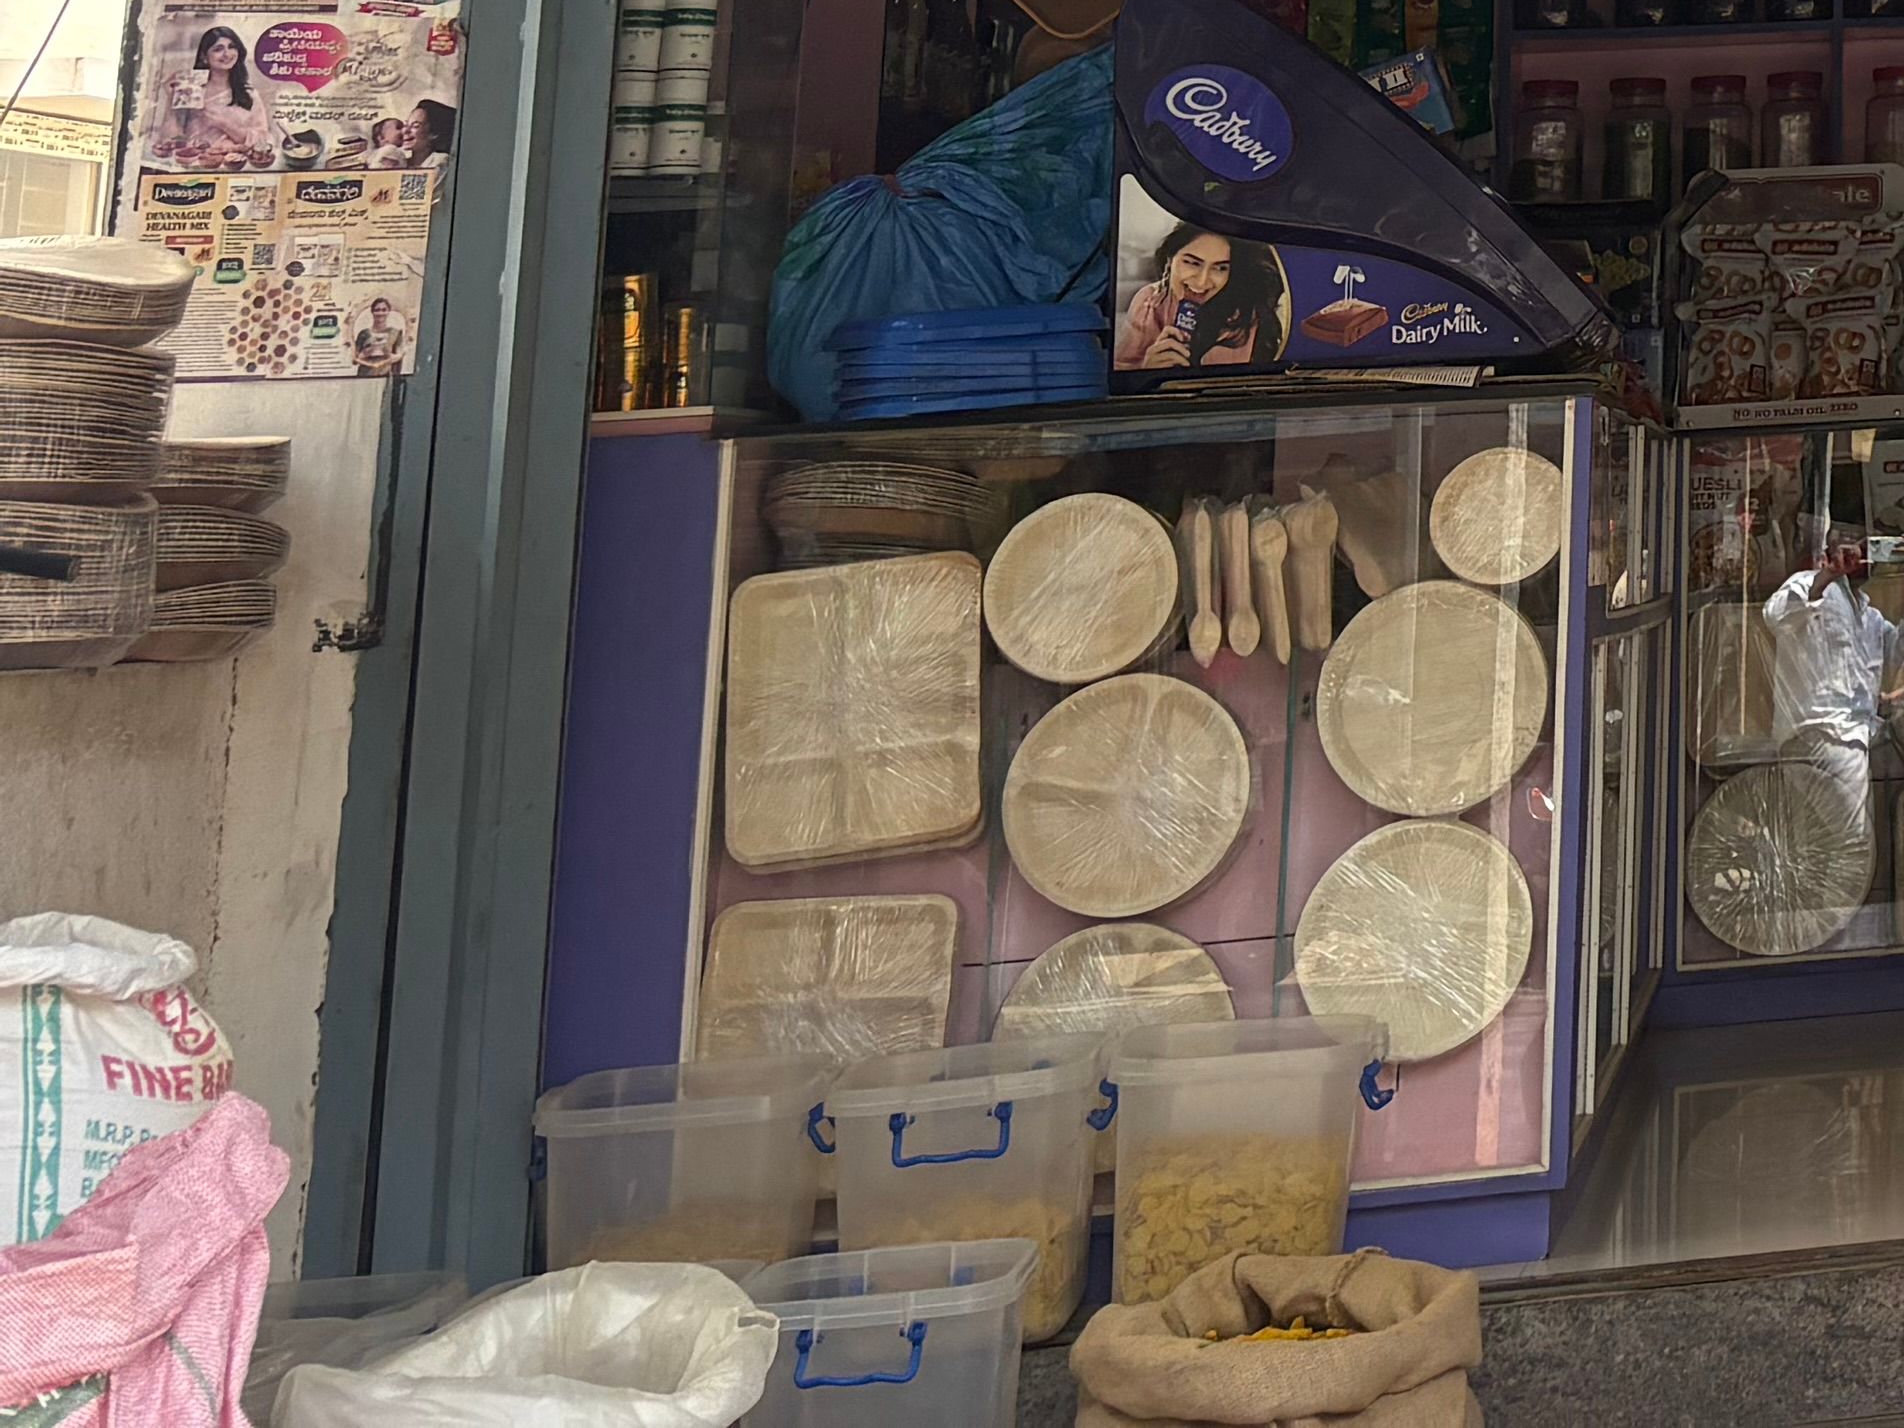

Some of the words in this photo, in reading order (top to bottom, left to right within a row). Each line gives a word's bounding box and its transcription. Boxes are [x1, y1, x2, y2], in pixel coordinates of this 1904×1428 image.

[1164, 76, 1279, 172] Cadbury
[1400, 302, 1449, 325] Cadbury
[1391, 320, 1441, 345] Dairy
[1443, 313, 1489, 337] Milk
[1690, 477, 1742, 492] UESLI
[102, 1055, 195, 1102] FINE
[85, 1118, 135, 1146] M.R.P.
